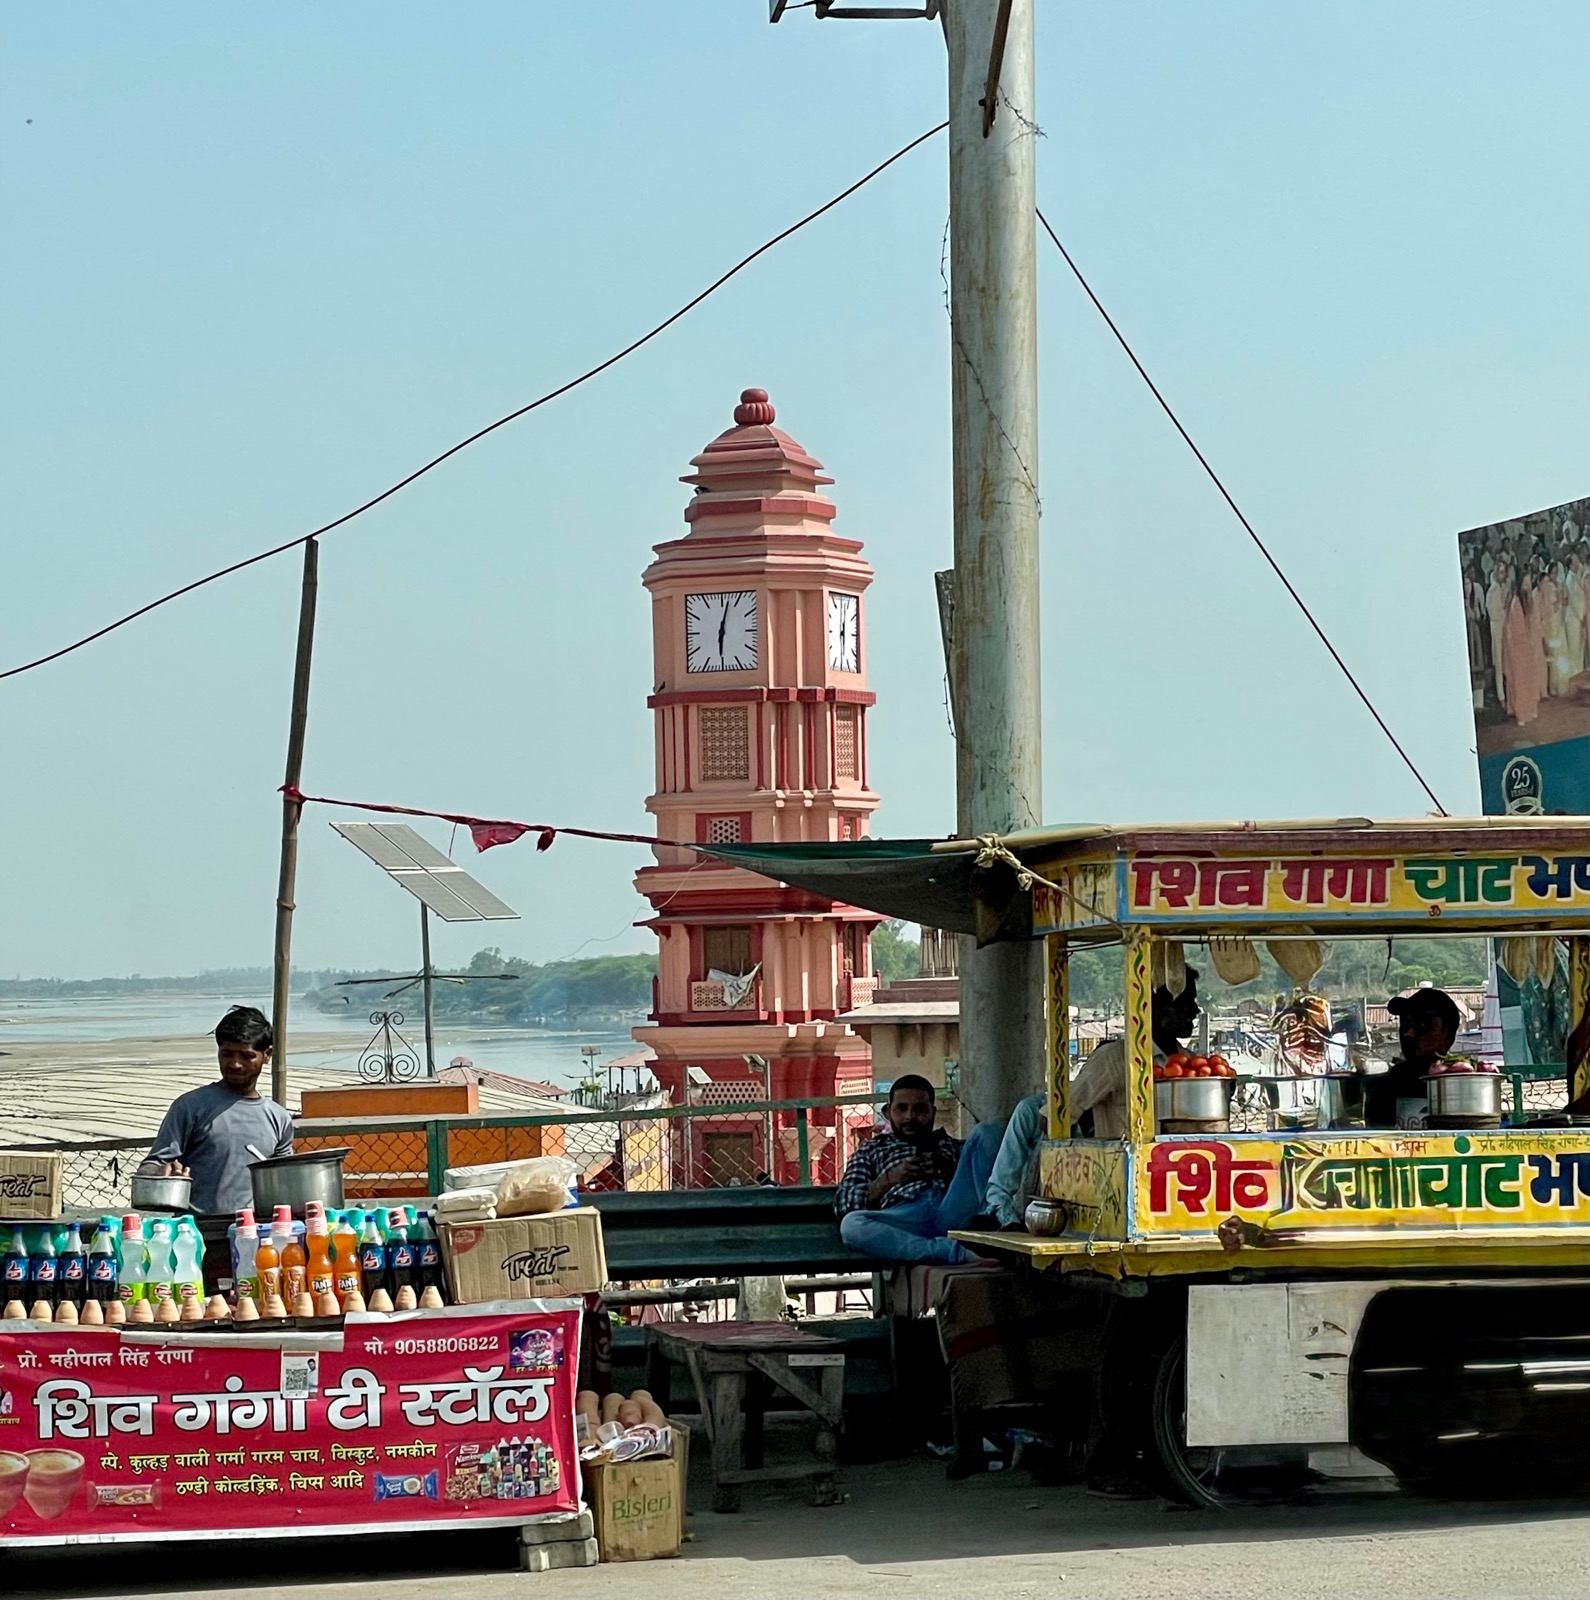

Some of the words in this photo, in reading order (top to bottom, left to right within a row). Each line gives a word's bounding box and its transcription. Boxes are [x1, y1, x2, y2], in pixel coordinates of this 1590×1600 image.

[1511, 766, 1530, 789] 25
[1131, 850, 1271, 908] शिव
[501, 1245, 570, 1281] Treat
[17, 1350, 42, 1368] प्रो.
[49, 1348, 113, 1369] महीपाल
[118, 1346, 150, 1368] सिंह
[155, 1348, 194, 1366] राणा
[364, 1336, 388, 1356] मो.
[395, 1336, 499, 1355] 9058806822
[33, 1378, 158, 1439] शिव
[172, 1376, 318, 1434] गंगा
[324, 1367, 387, 1430] टी
[399, 1366, 555, 1425] स्टॉल
[129, 1454, 170, 1475] कुल्हड़
[174, 1448, 210, 1468] वाली
[215, 1446, 245, 1466] गर्मा
[251, 1450, 285, 1465] गरम
[290, 1448, 325, 1466] चाय,
[385, 1439, 438, 1459] नमकीन
[289, 1471, 325, 1491] चिप्स
[330, 1469, 364, 1489] आदि
[611, 1490, 672, 1521] Bisleri
